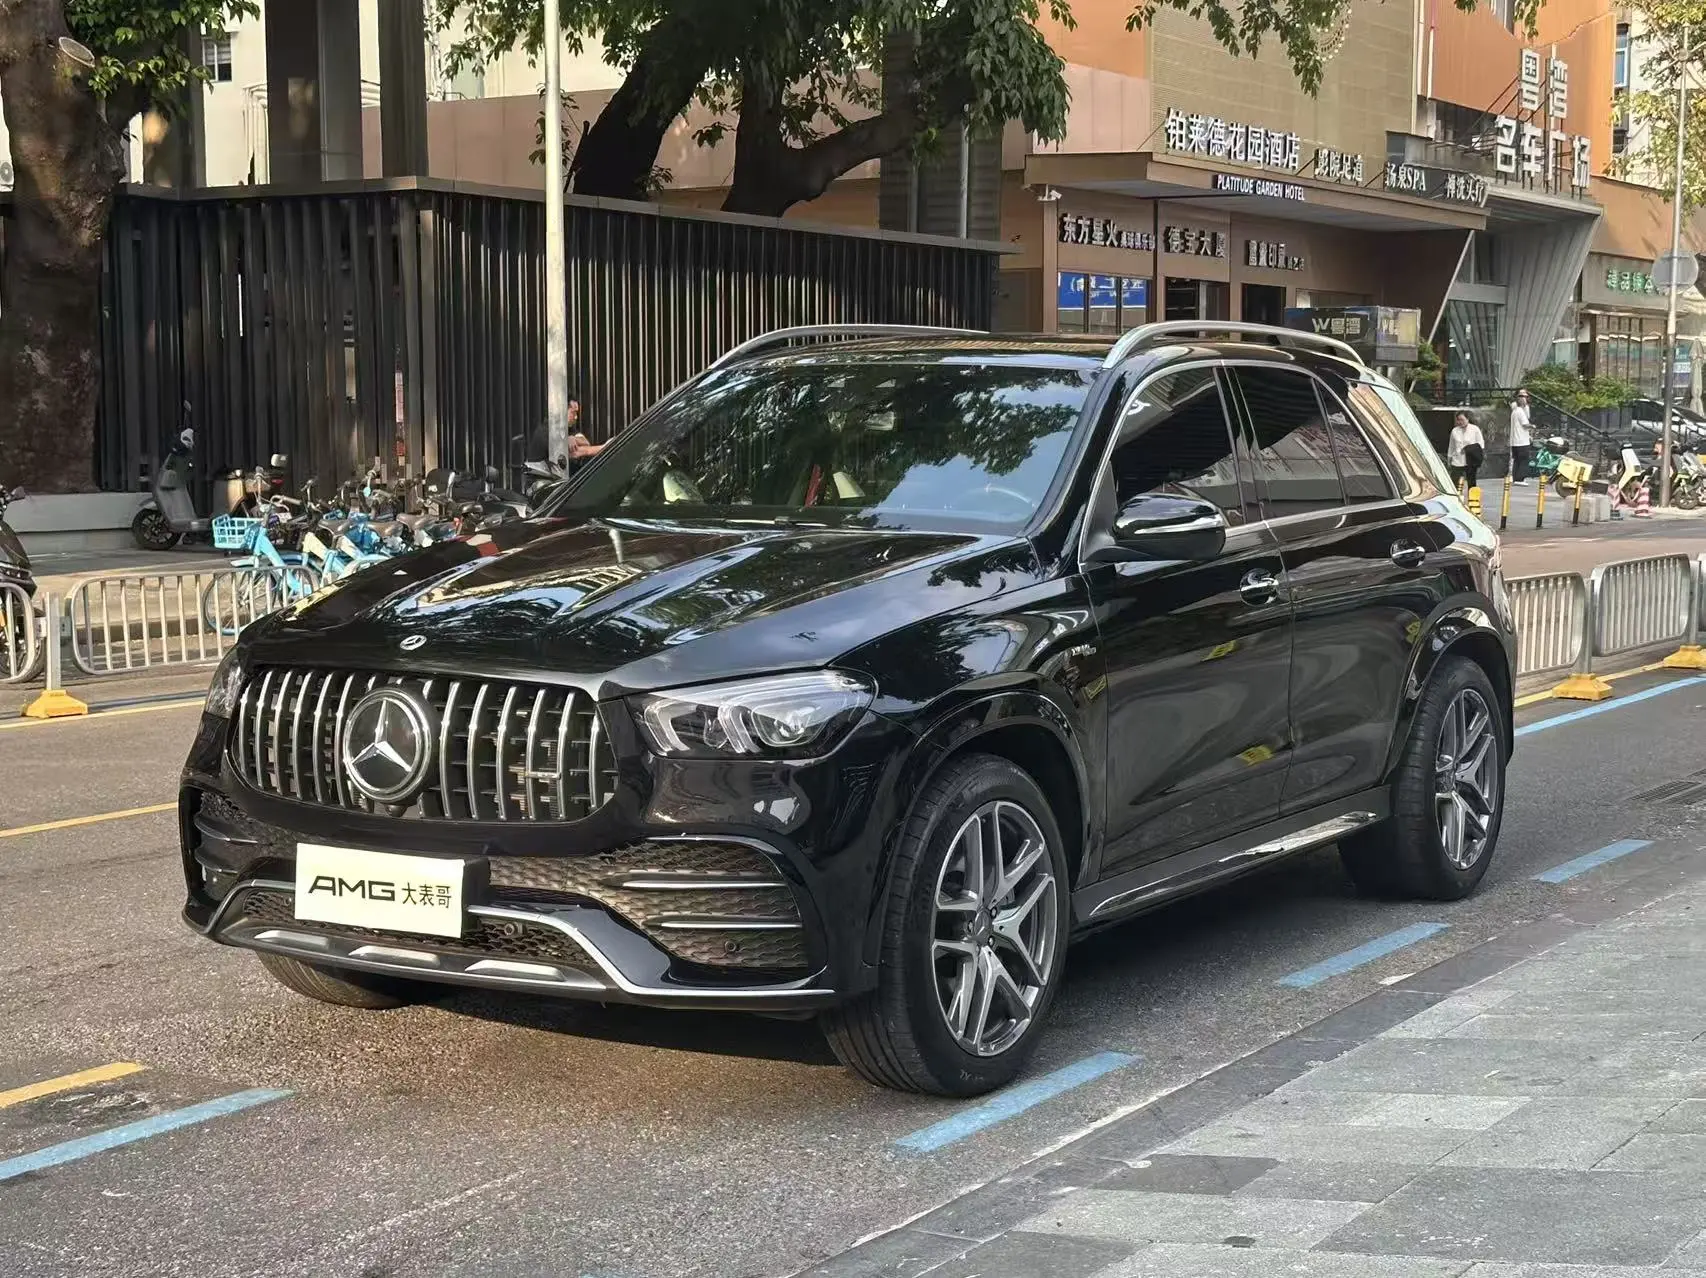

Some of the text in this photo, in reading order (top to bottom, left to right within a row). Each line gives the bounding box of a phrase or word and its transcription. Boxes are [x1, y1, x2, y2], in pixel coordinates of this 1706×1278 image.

[1165, 108, 1301, 169] 铂莱德花园酒店
[1495, 115, 1591, 188] 名车广场
[1315, 149, 1364, 182] 影院足道
[1217, 174, 1305, 201] PLATITUDE GARDEN HOTEL
[308, 875, 452, 909] AMG 大表哥
